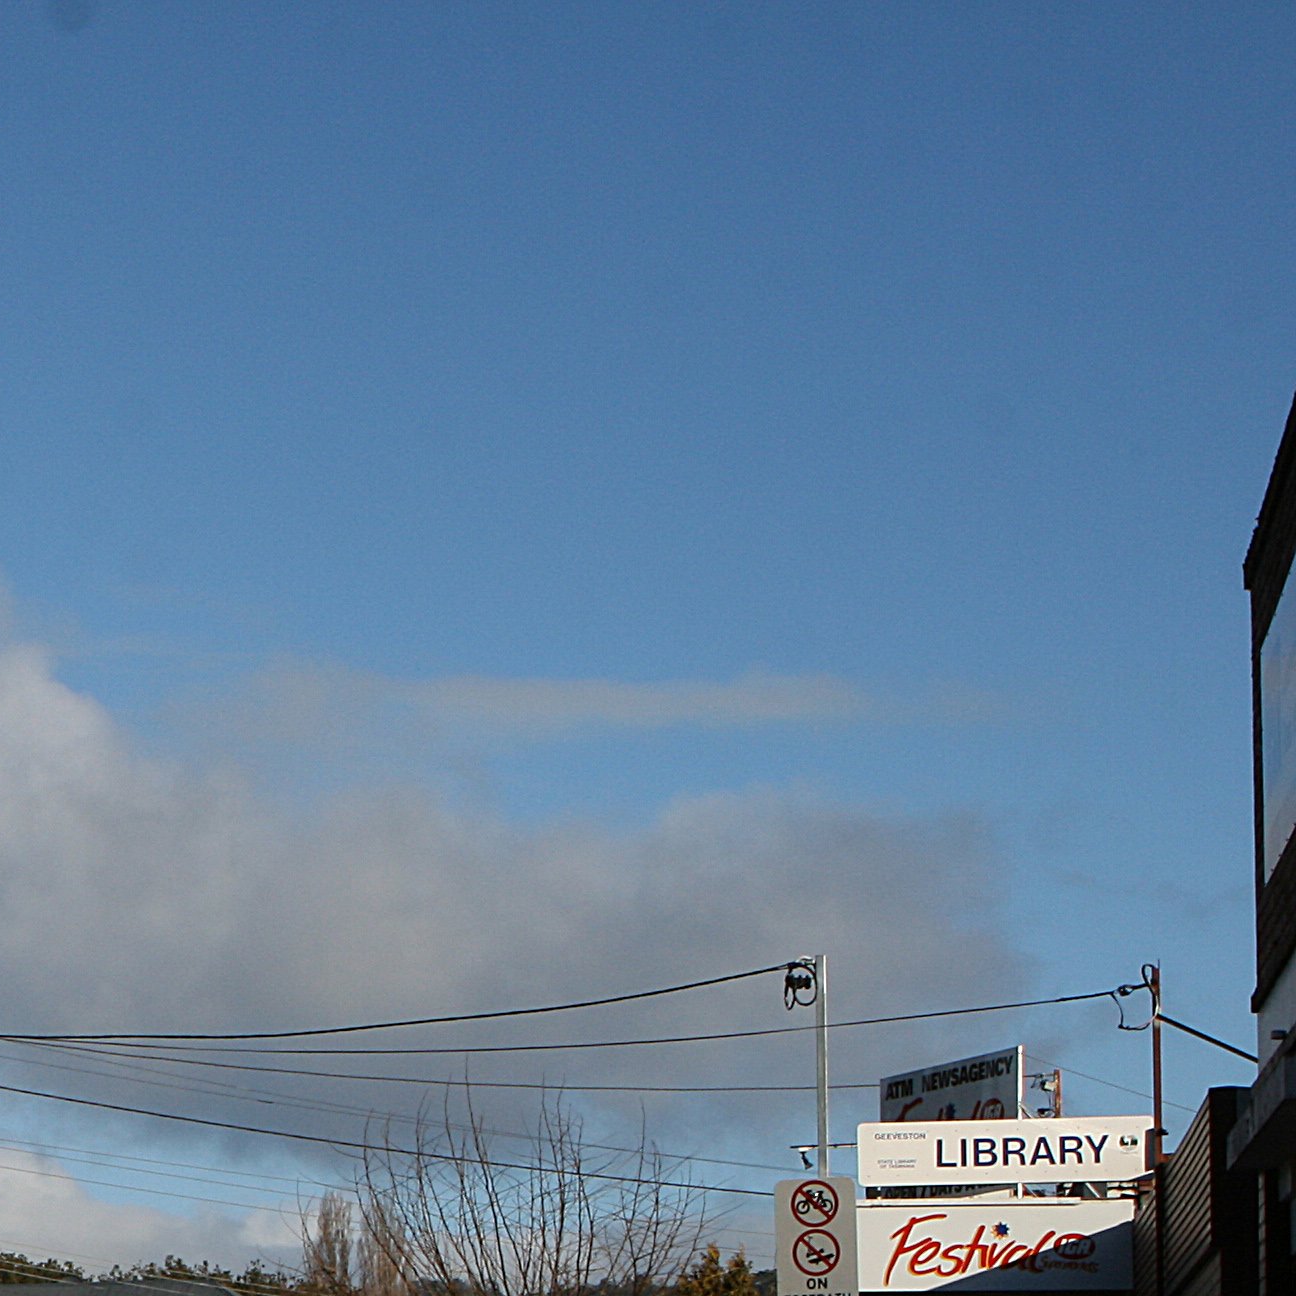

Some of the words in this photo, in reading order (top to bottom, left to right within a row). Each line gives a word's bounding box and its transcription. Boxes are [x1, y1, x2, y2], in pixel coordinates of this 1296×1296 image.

[886, 1078, 913, 1100] ATM
[922, 1055, 1013, 1092] NEWSAGENCY
[874, 1132, 926, 1141] GEEVESTON
[936, 1134, 1109, 1168] LIBRARY
[883, 1214, 1056, 1287] Festival
[807, 1278, 828, 1290] ON
